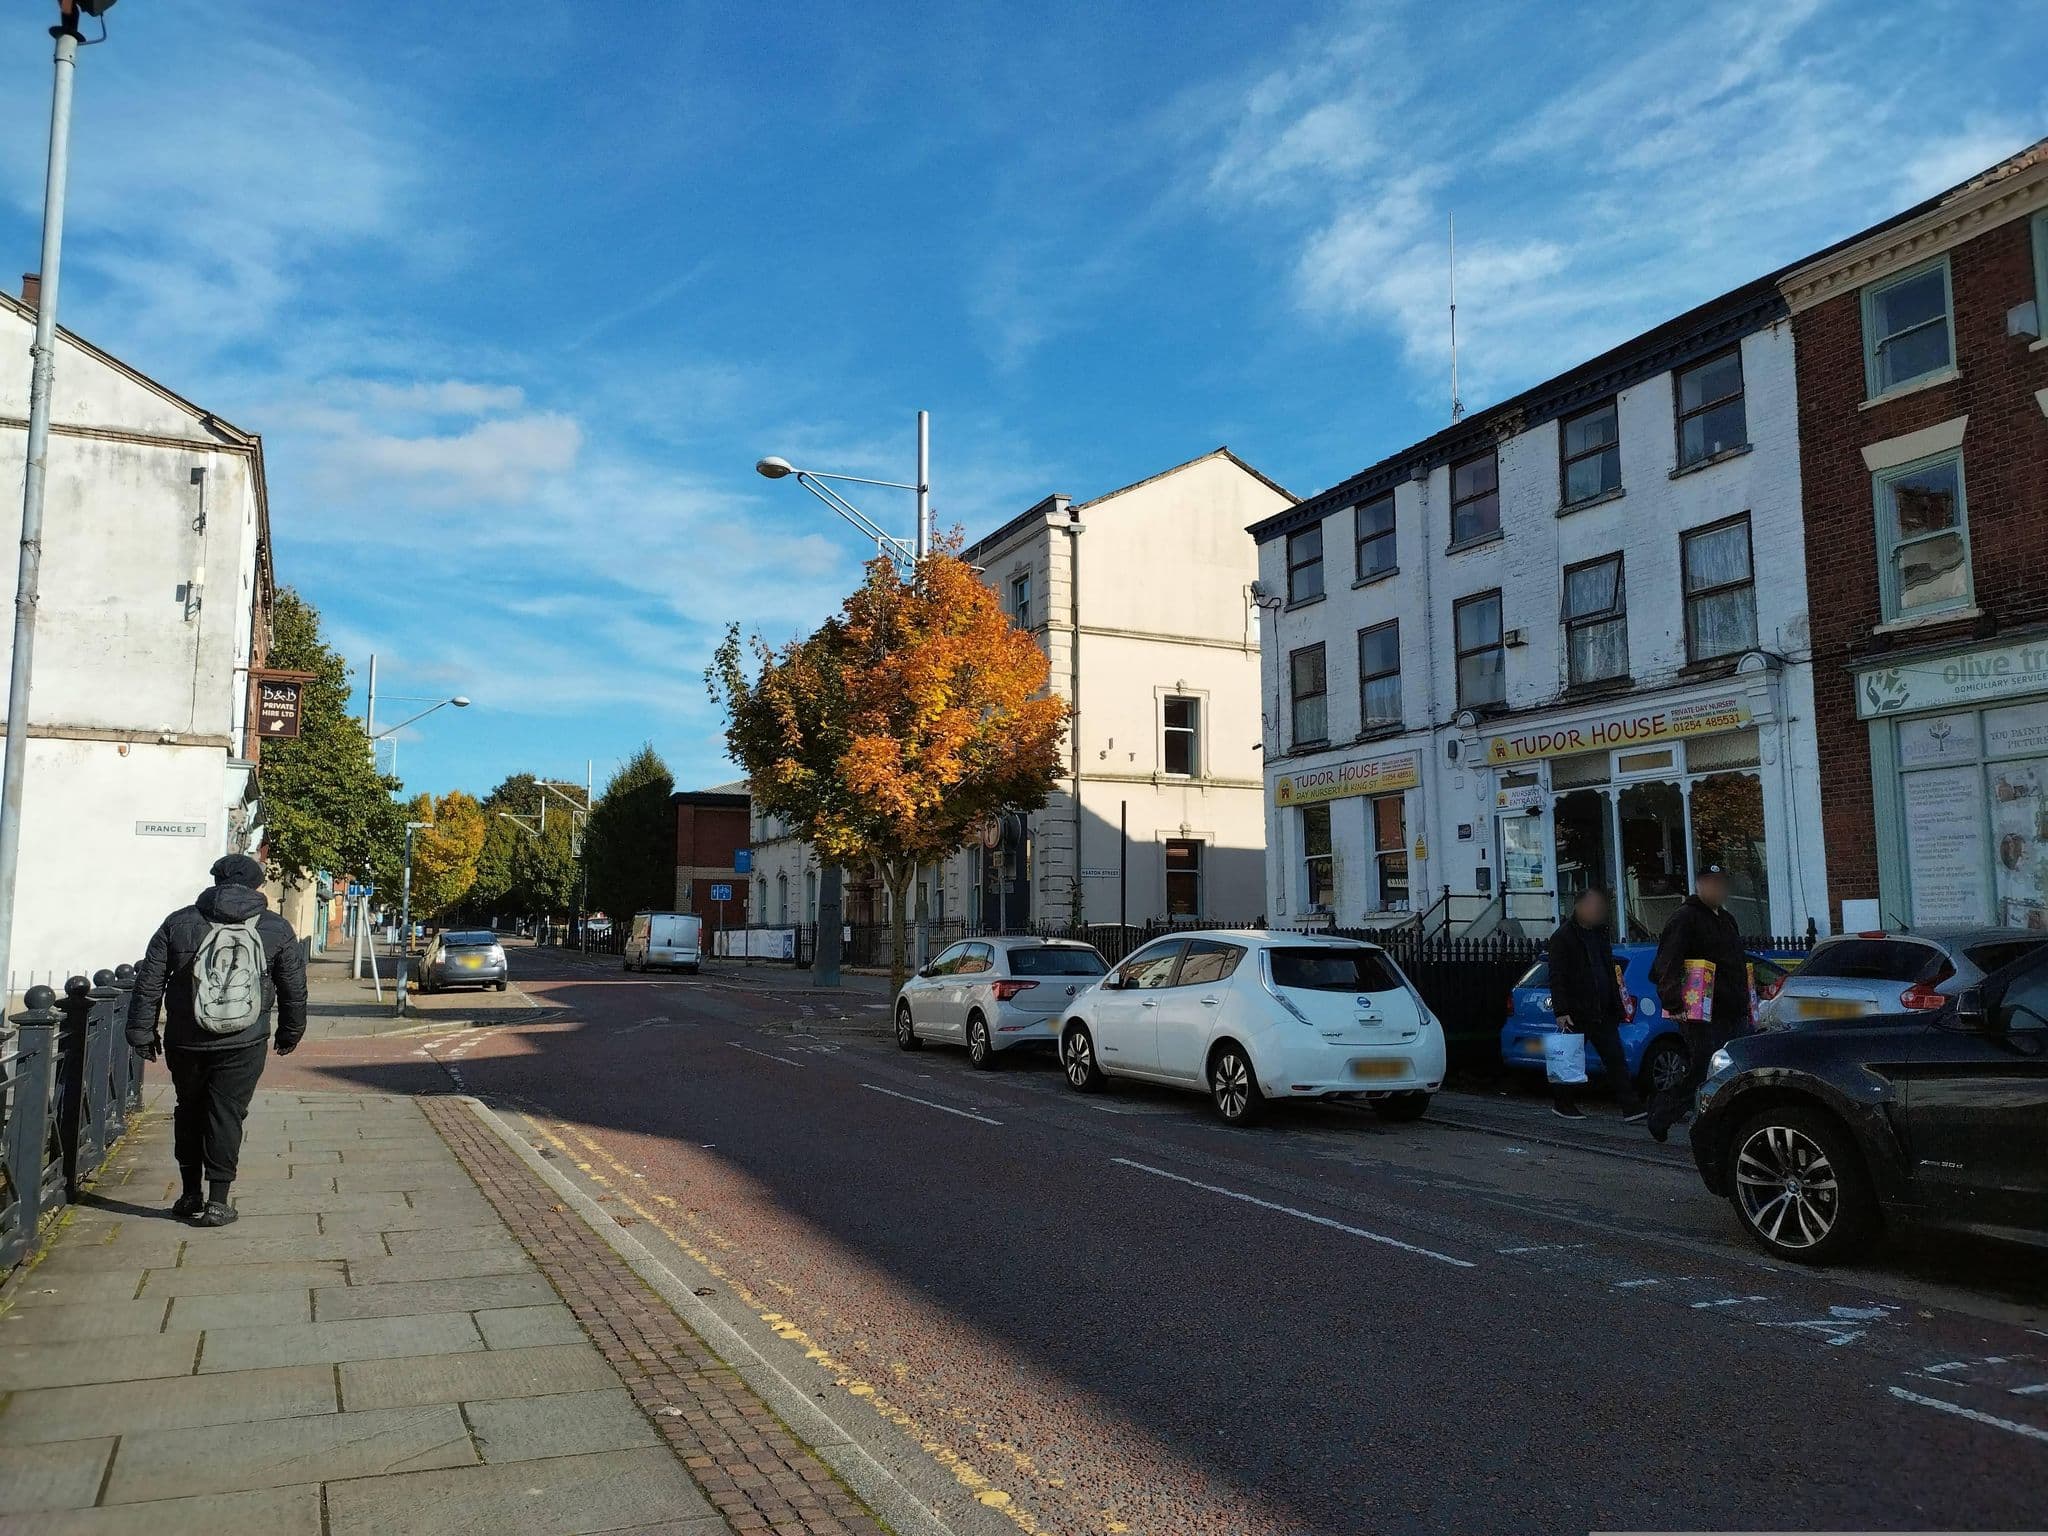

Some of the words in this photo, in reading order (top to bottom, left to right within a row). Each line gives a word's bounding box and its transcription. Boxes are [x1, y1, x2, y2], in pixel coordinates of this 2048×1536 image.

[1943, 655, 2010, 685] olive
[263, 685, 297, 702] B&B
[1954, 678, 2009, 694] DOMICILIARY
[263, 702, 295, 711] PRIVATE
[1671, 706, 1695, 717] PRIVATE
[1695, 704, 1708, 713] DAY
[1708, 700, 1737, 710] NURSERY
[1673, 720, 1702, 733] 01254
[1705, 713, 1740, 727] 485531
[1511, 730, 1585, 756] TUDOR
[1592, 713, 1668, 745] HOUSE
[1990, 731, 2008, 741] YOU
[2011, 726, 2042, 738] PAINT
[1294, 770, 1335, 790] TUDOR
[1339, 762, 1380, 781] HOUSE
[1296, 791, 1309, 800] DAY
[1311, 785, 1341, 798] NURSERY
[1350, 781, 1368, 791] KING
[1368, 780, 1379, 790] ST
[145, 825, 183, 833] FRANCE
